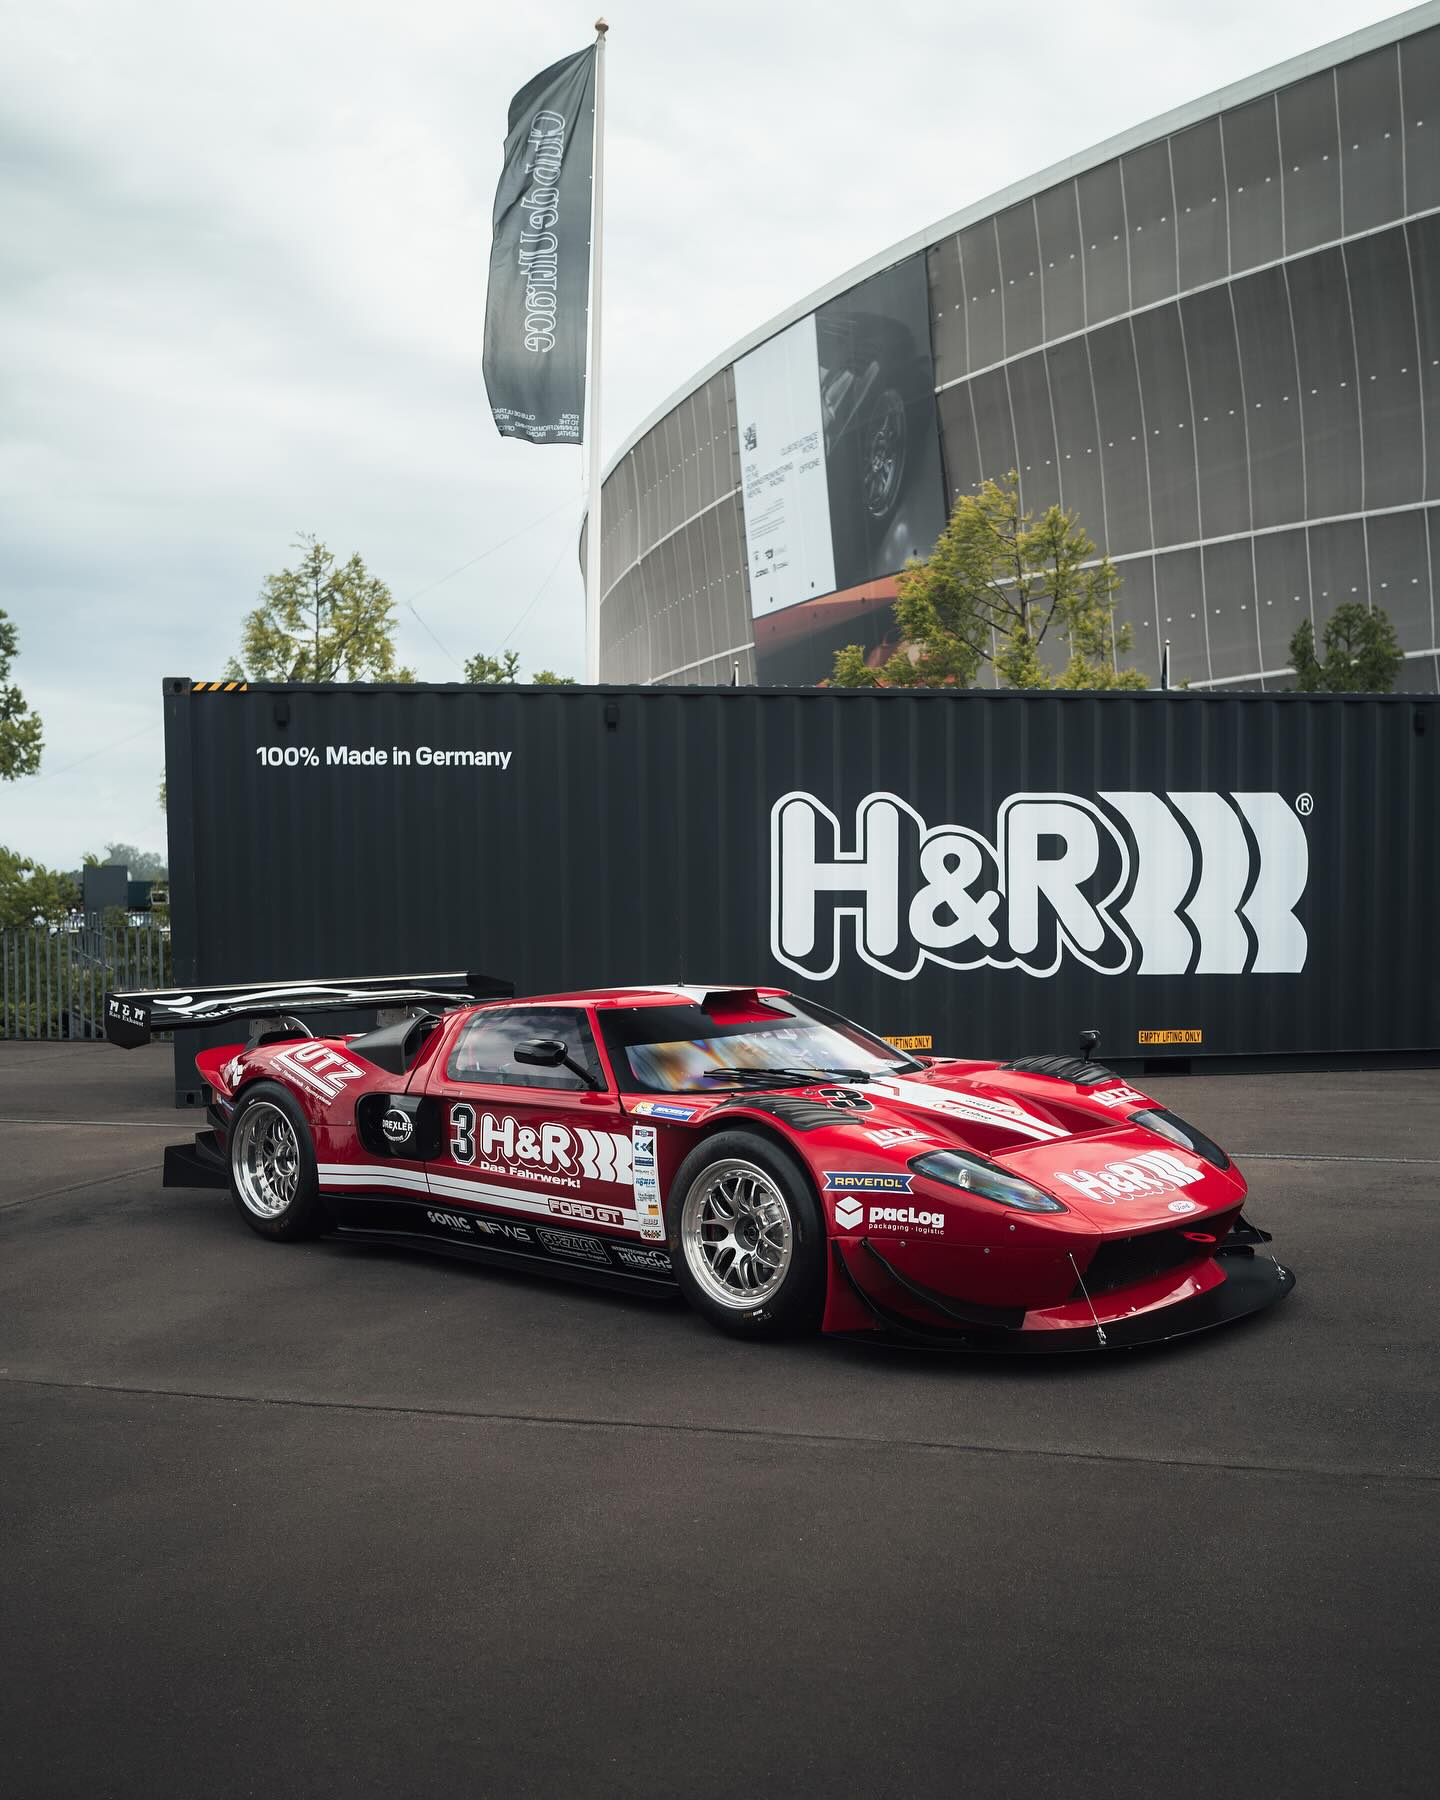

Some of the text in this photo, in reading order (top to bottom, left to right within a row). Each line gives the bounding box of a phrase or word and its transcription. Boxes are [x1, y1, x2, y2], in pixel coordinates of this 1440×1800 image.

[256, 746, 512, 770] 100% Made in Germany
[770, 791, 1132, 981] H&R
[109, 999, 120, 1013] M
[134, 1007, 146, 1021] M
[914, 1037, 930, 1048] ONLY
[1140, 1031, 1201, 1042] EMPTY LIFTING ONLY
[818, 1087, 876, 1112] 3
[450, 1103, 477, 1166] 3
[480, 1112, 580, 1177] H&R
[480, 1160, 581, 1189] Das Fahrwerk!
[834, 1177, 903, 1188] RAVENOL
[1053, 1161, 1176, 1205] H&R
[549, 1200, 595, 1219] FORD
[595, 1208, 621, 1224] GT
[869, 1207, 945, 1228] pacLog
[486, 1222, 532, 1241] FWS
[868, 1223, 945, 1236] packaging logistic
